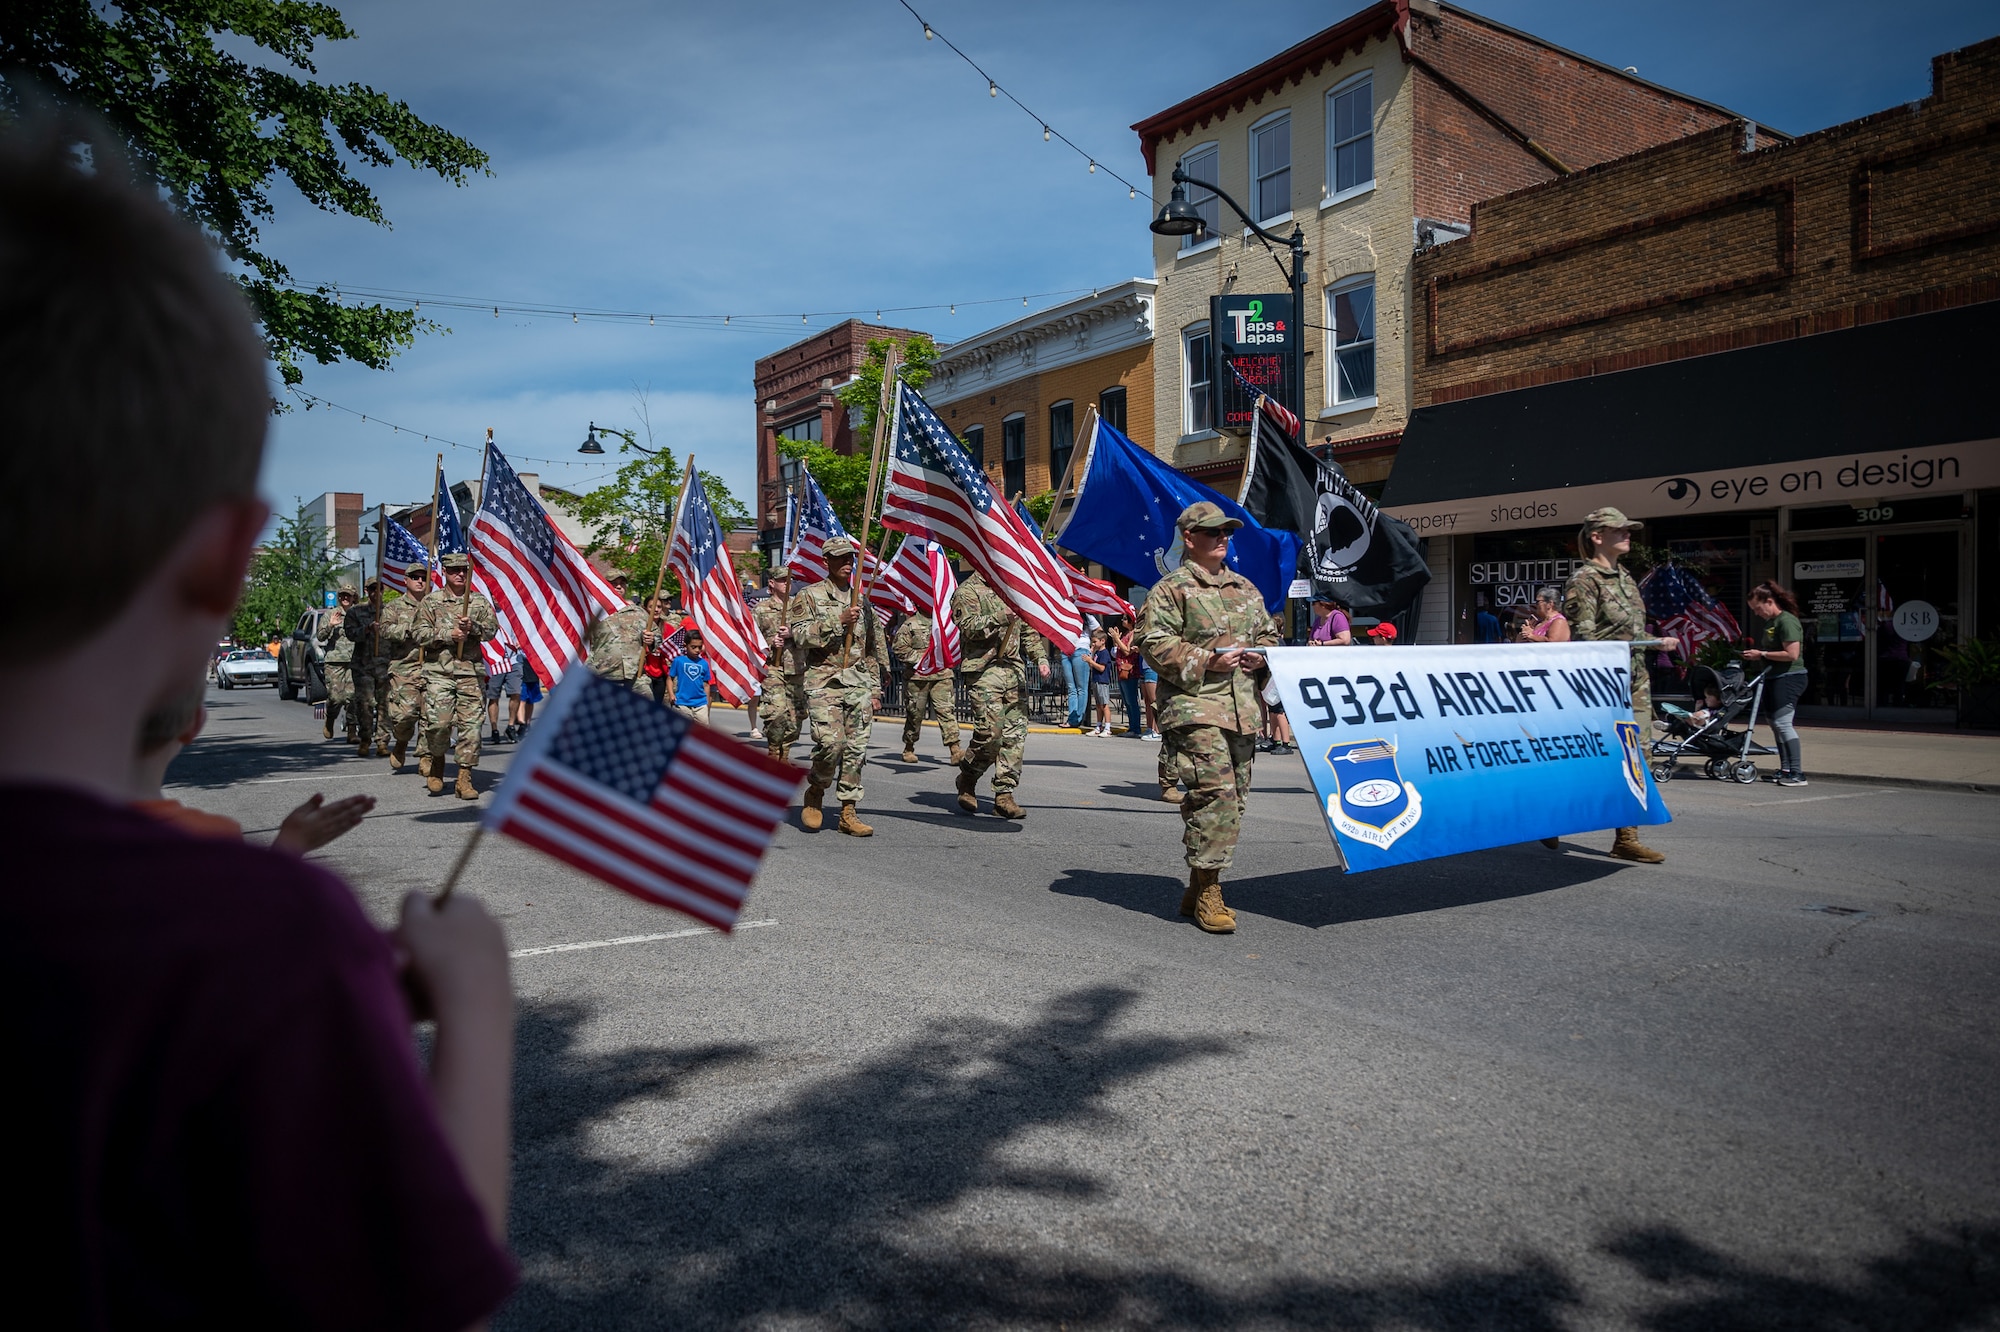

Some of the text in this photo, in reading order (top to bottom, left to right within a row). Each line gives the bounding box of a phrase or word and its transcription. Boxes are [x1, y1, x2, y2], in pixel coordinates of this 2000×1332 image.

[1711, 454, 1960, 503] eye on design
[1400, 513, 1458, 532] rapery
[1490, 500, 1557, 523] shades
[1857, 507, 1894, 522] 309
[1299, 671, 1424, 730] 932d
[1427, 669, 1564, 717] AIRLIFT
[1425, 733, 1610, 774] AIR FORCE RESERVE
